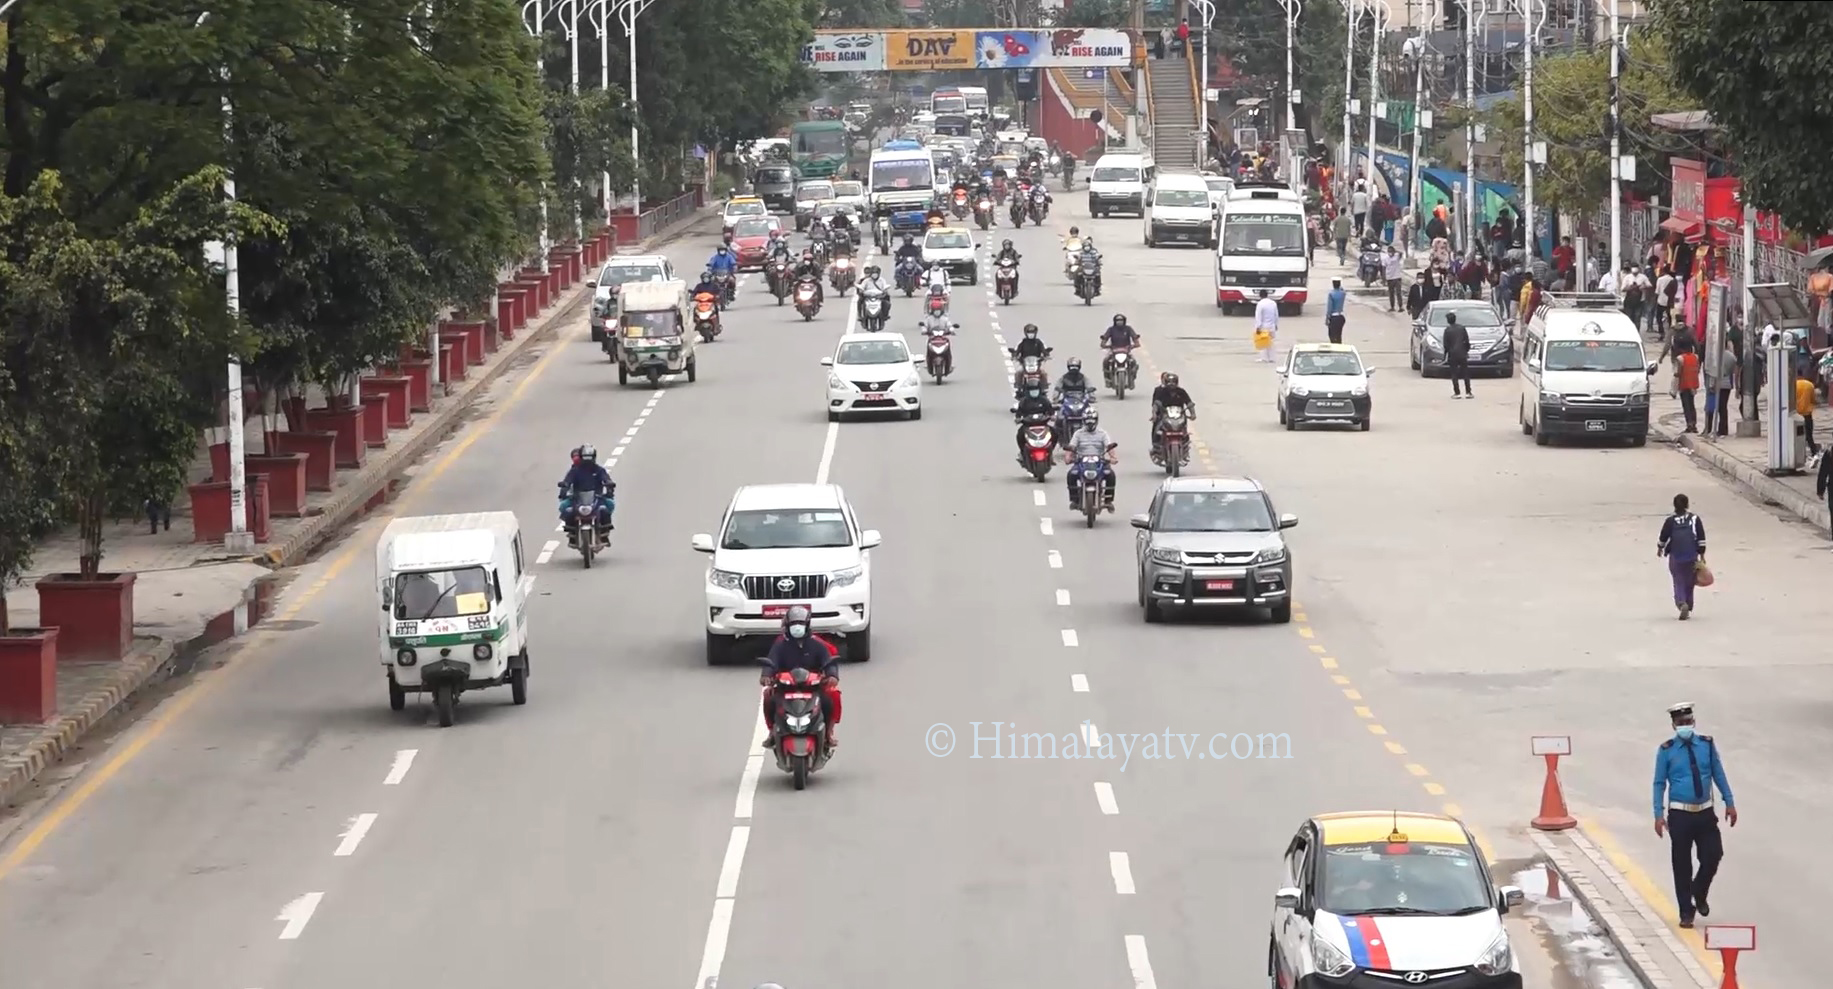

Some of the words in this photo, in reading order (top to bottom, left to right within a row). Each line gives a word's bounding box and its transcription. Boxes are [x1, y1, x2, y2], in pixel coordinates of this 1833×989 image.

[908, 38, 955, 56] DAV
[1072, 47, 1093, 57] RISE
[1094, 46, 1123, 57] AGAIN
[815, 51, 836, 62] RISE
[838, 51, 866, 62] AGAIN
